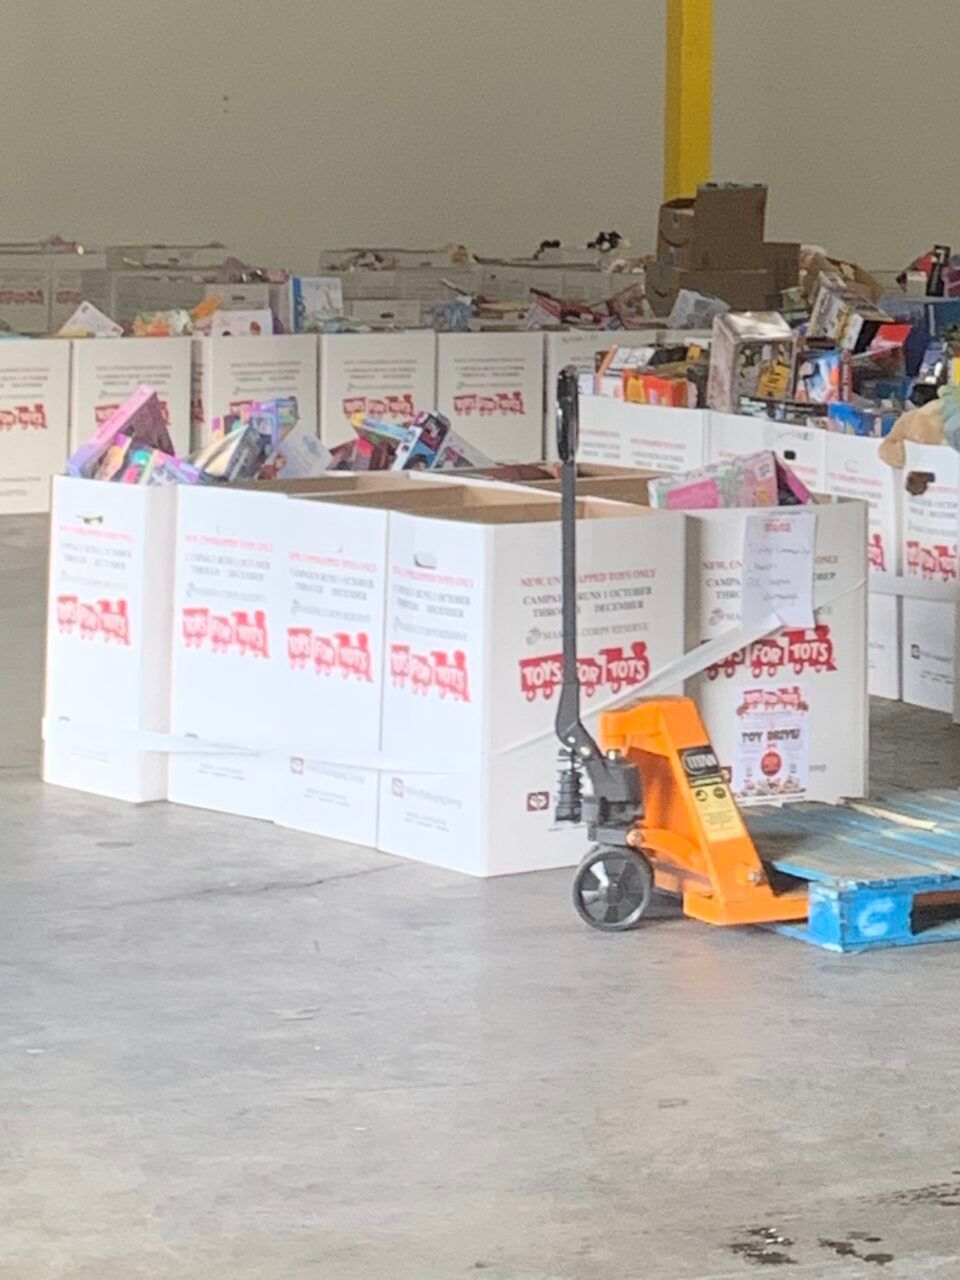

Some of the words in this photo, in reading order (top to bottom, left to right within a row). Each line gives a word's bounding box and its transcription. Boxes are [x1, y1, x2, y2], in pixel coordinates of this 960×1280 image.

[595, 601, 644, 614] DECEMBER
[752, 642, 780, 663] FOR
[790, 641, 828, 662] TOTS
[522, 661, 562, 687] TOYS
[608, 660, 646, 684] TOTS
[741, 731, 763, 743] TOY
